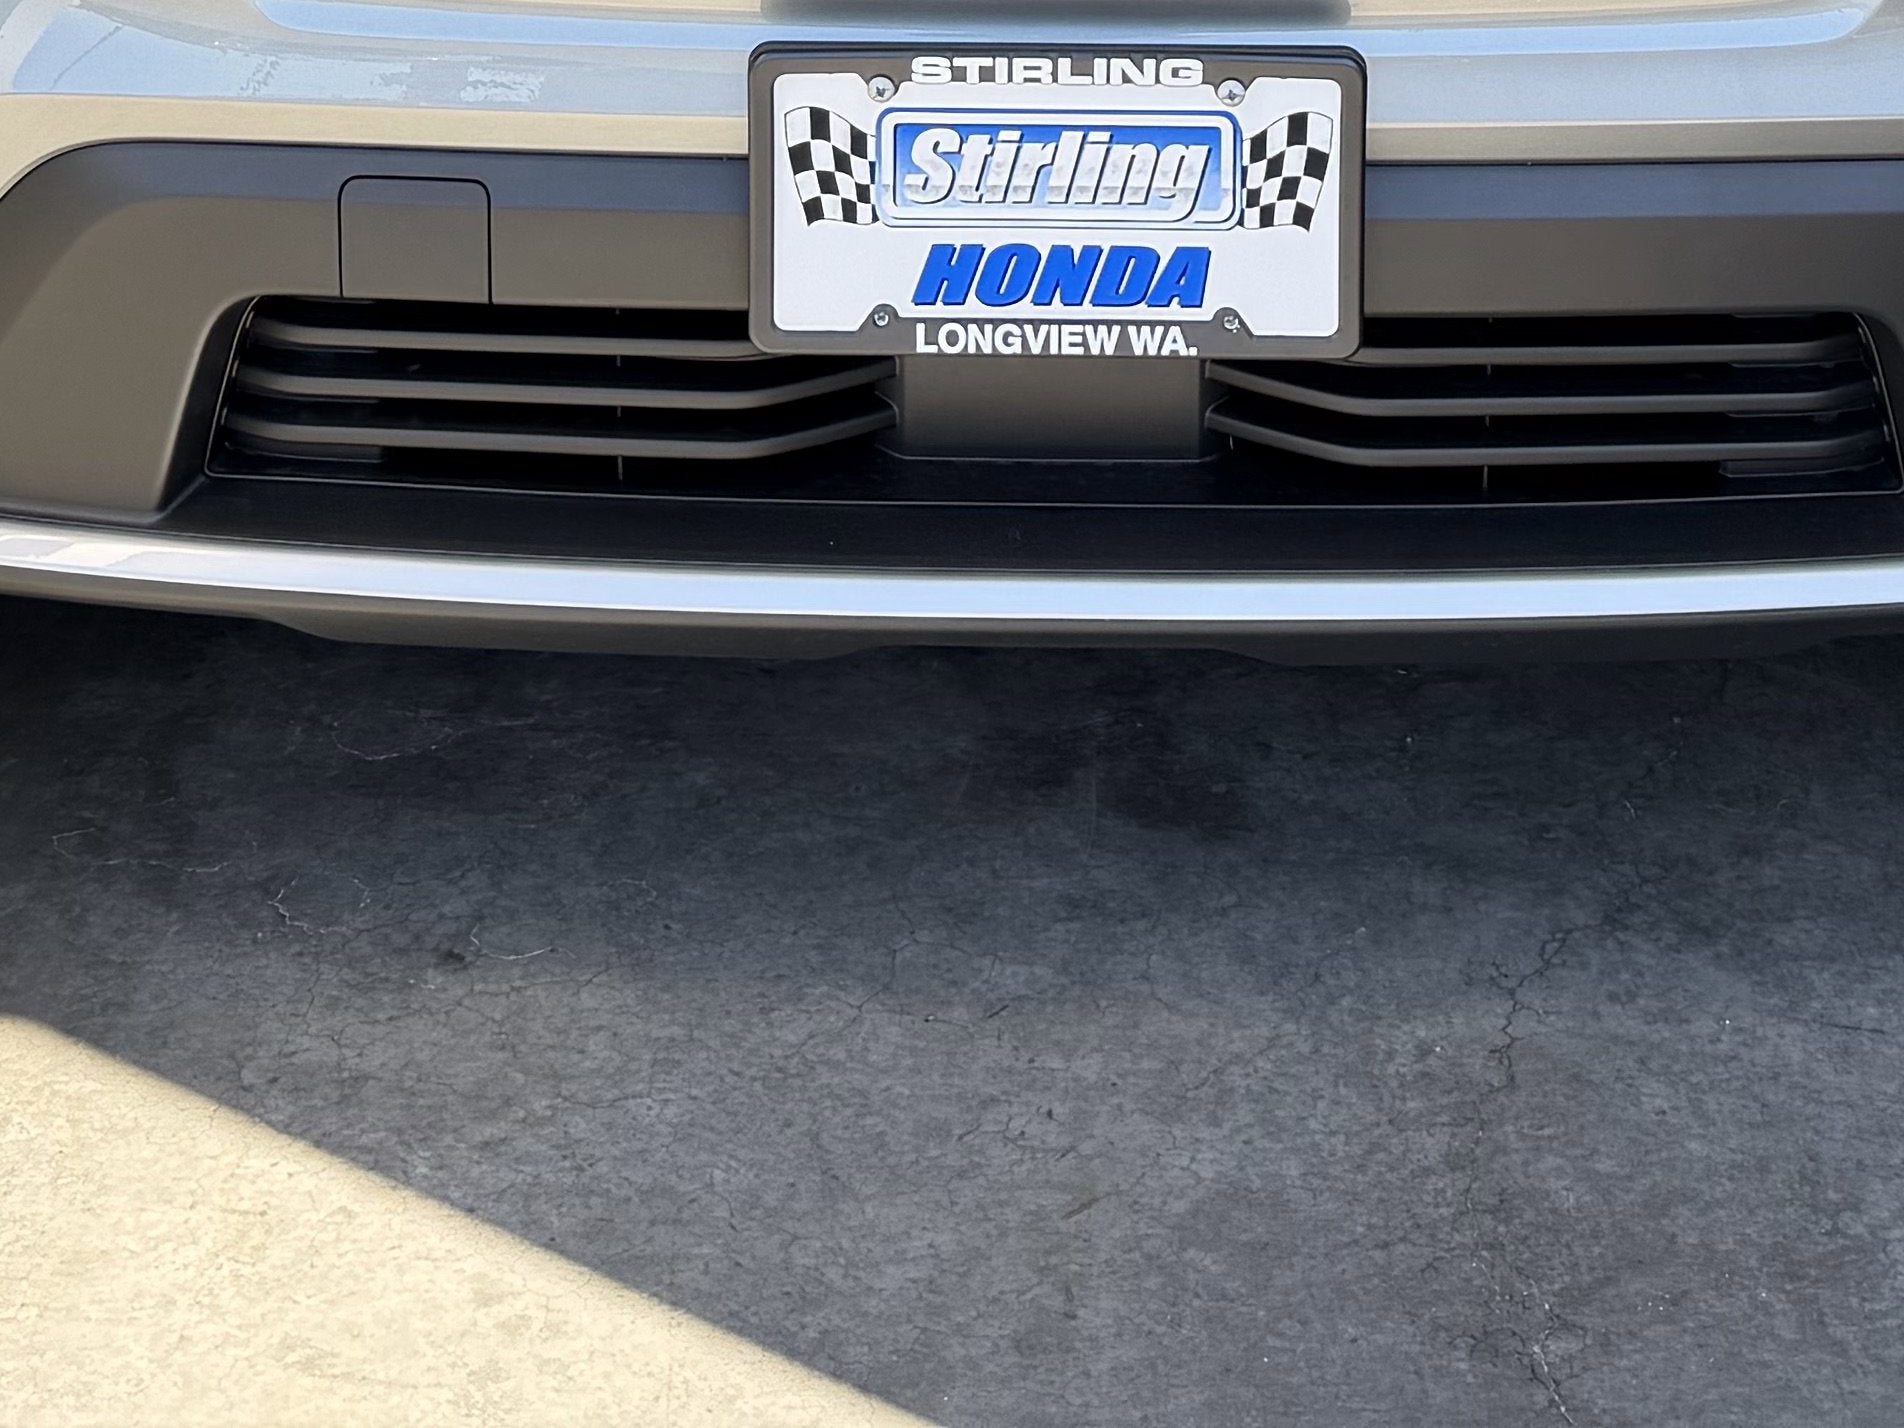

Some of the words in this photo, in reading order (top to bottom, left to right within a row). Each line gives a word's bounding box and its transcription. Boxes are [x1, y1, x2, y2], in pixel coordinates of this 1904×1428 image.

[911, 56, 1204, 88] STIRLING
[903, 127, 1213, 223] Stirling
[911, 243, 1212, 308] HONDA
[915, 322, 1121, 356] LONGVIEW
[1127, 324, 1199, 357] WA.
